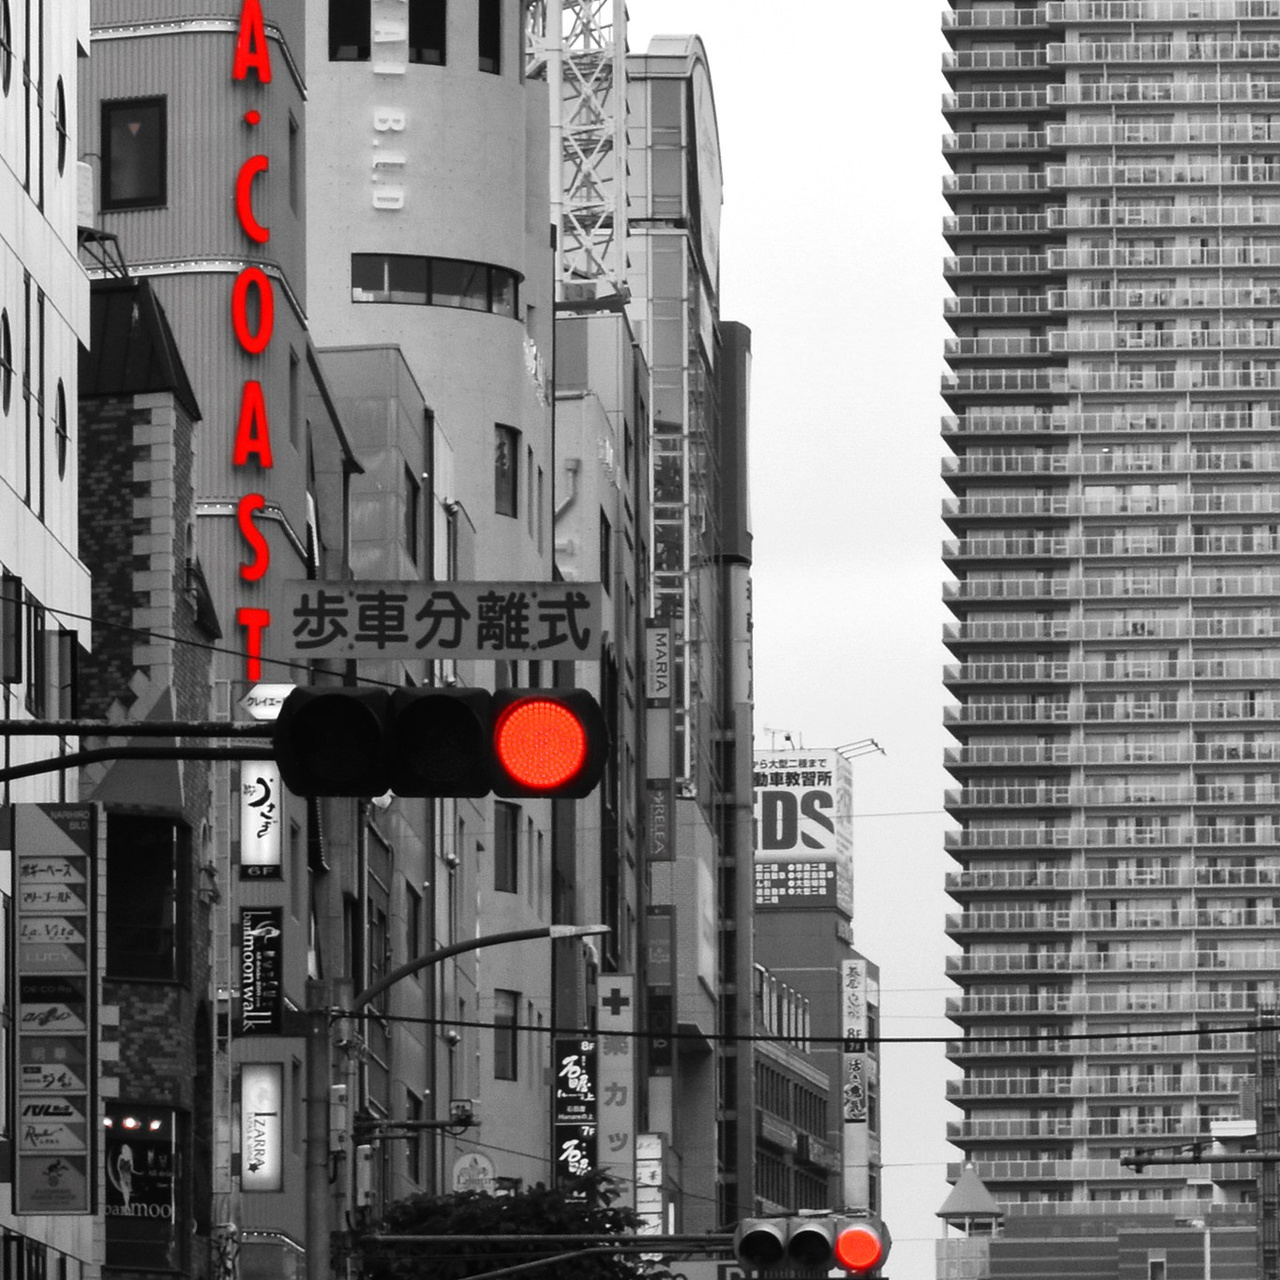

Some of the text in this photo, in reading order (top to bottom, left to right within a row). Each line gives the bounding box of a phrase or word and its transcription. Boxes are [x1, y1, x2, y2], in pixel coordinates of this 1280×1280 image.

[293, 588, 590, 652] 歩車分離式
[656, 632, 668, 692] MARIA
[247, 697, 286, 707] クレイエー
[752, 789, 835, 850] DS
[247, 866, 274, 877] 6F
[581, 1040, 595, 1051] 8F
[253, 1111, 278, 1167] IZARRA
[581, 1125, 596, 1136] 7F
